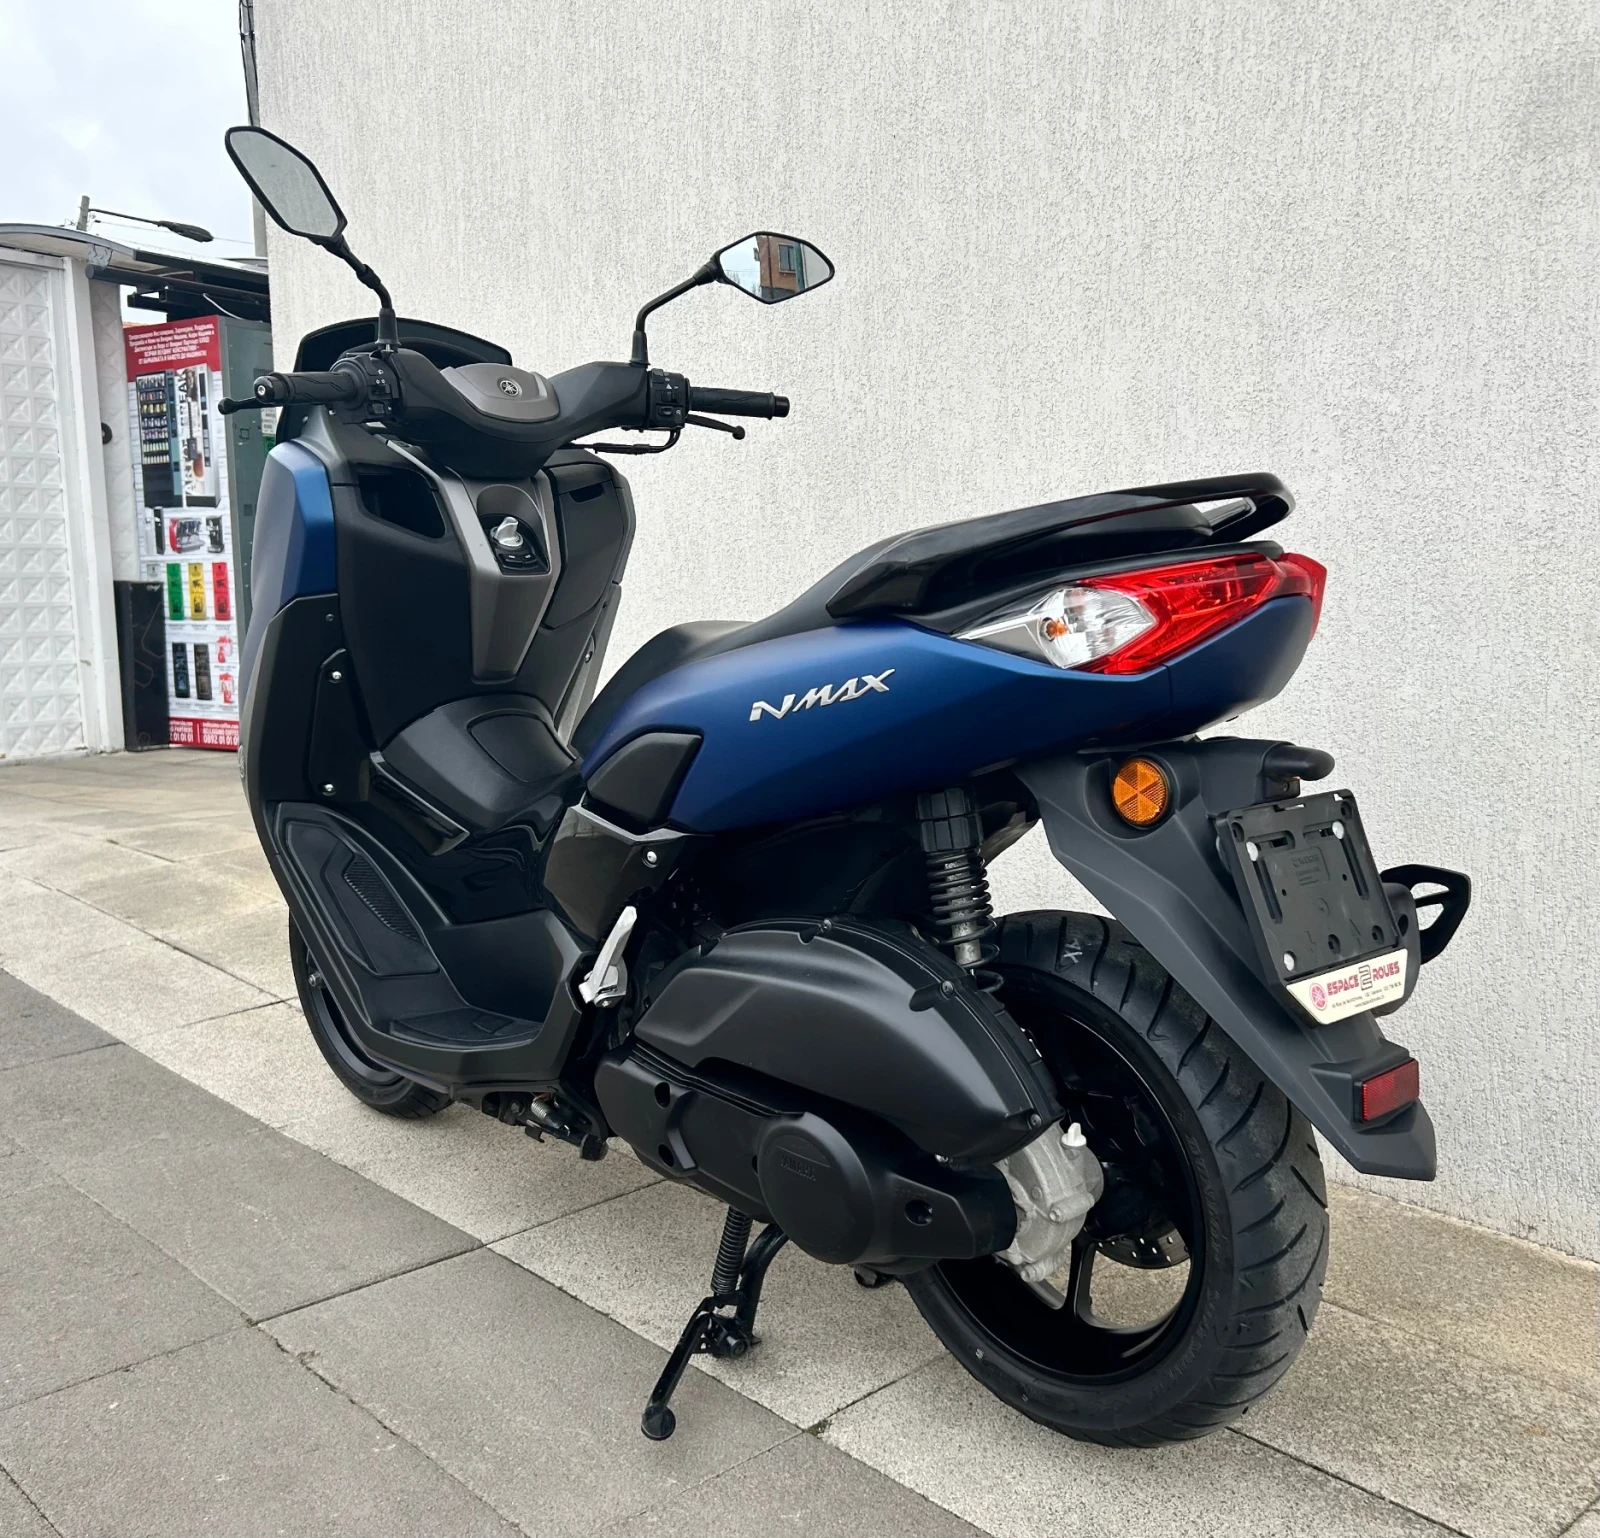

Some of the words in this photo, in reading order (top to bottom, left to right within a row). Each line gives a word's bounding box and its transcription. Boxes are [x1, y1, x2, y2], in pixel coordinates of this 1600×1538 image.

[749, 668, 896, 722] NMAX
[1326, 973, 1360, 997] ESPACE
[1372, 960, 1400, 982] ROUES
